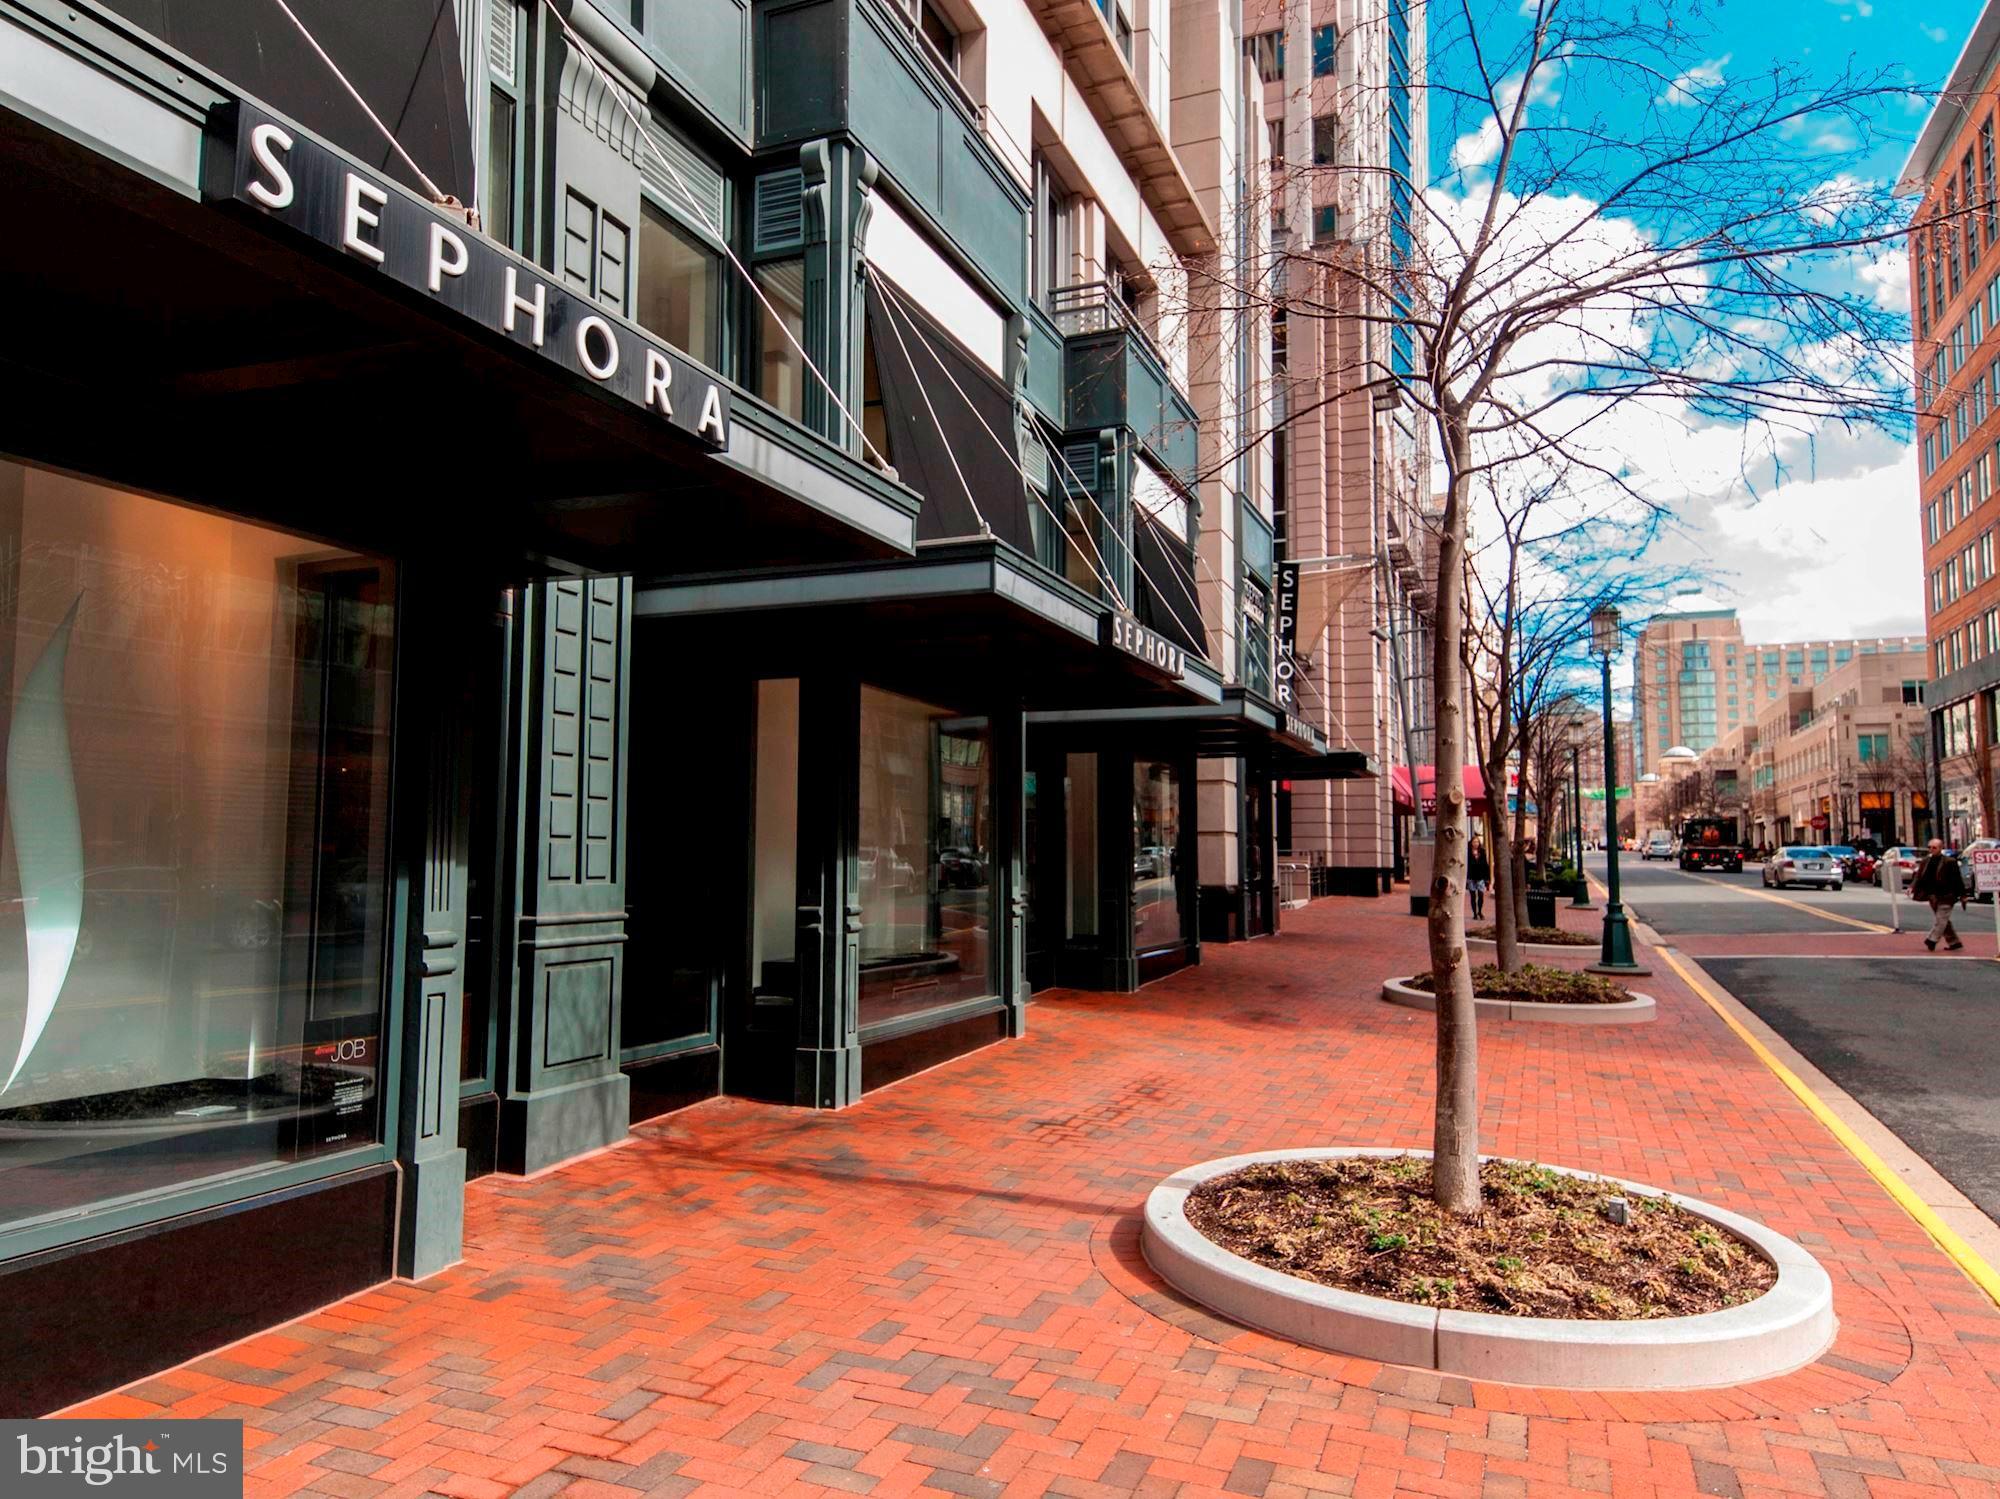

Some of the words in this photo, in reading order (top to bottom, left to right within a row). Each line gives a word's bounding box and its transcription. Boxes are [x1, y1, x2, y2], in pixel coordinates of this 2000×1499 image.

[247, 123, 725, 443] SEPHORA
[1114, 616, 1185, 677] SEPHORA
[1276, 570, 1295, 703] SEPHOR
[1286, 714, 1315, 742] SEPHORA
[1975, 852, 2000, 863] STO
[331, 1039, 366, 1062] JOB
